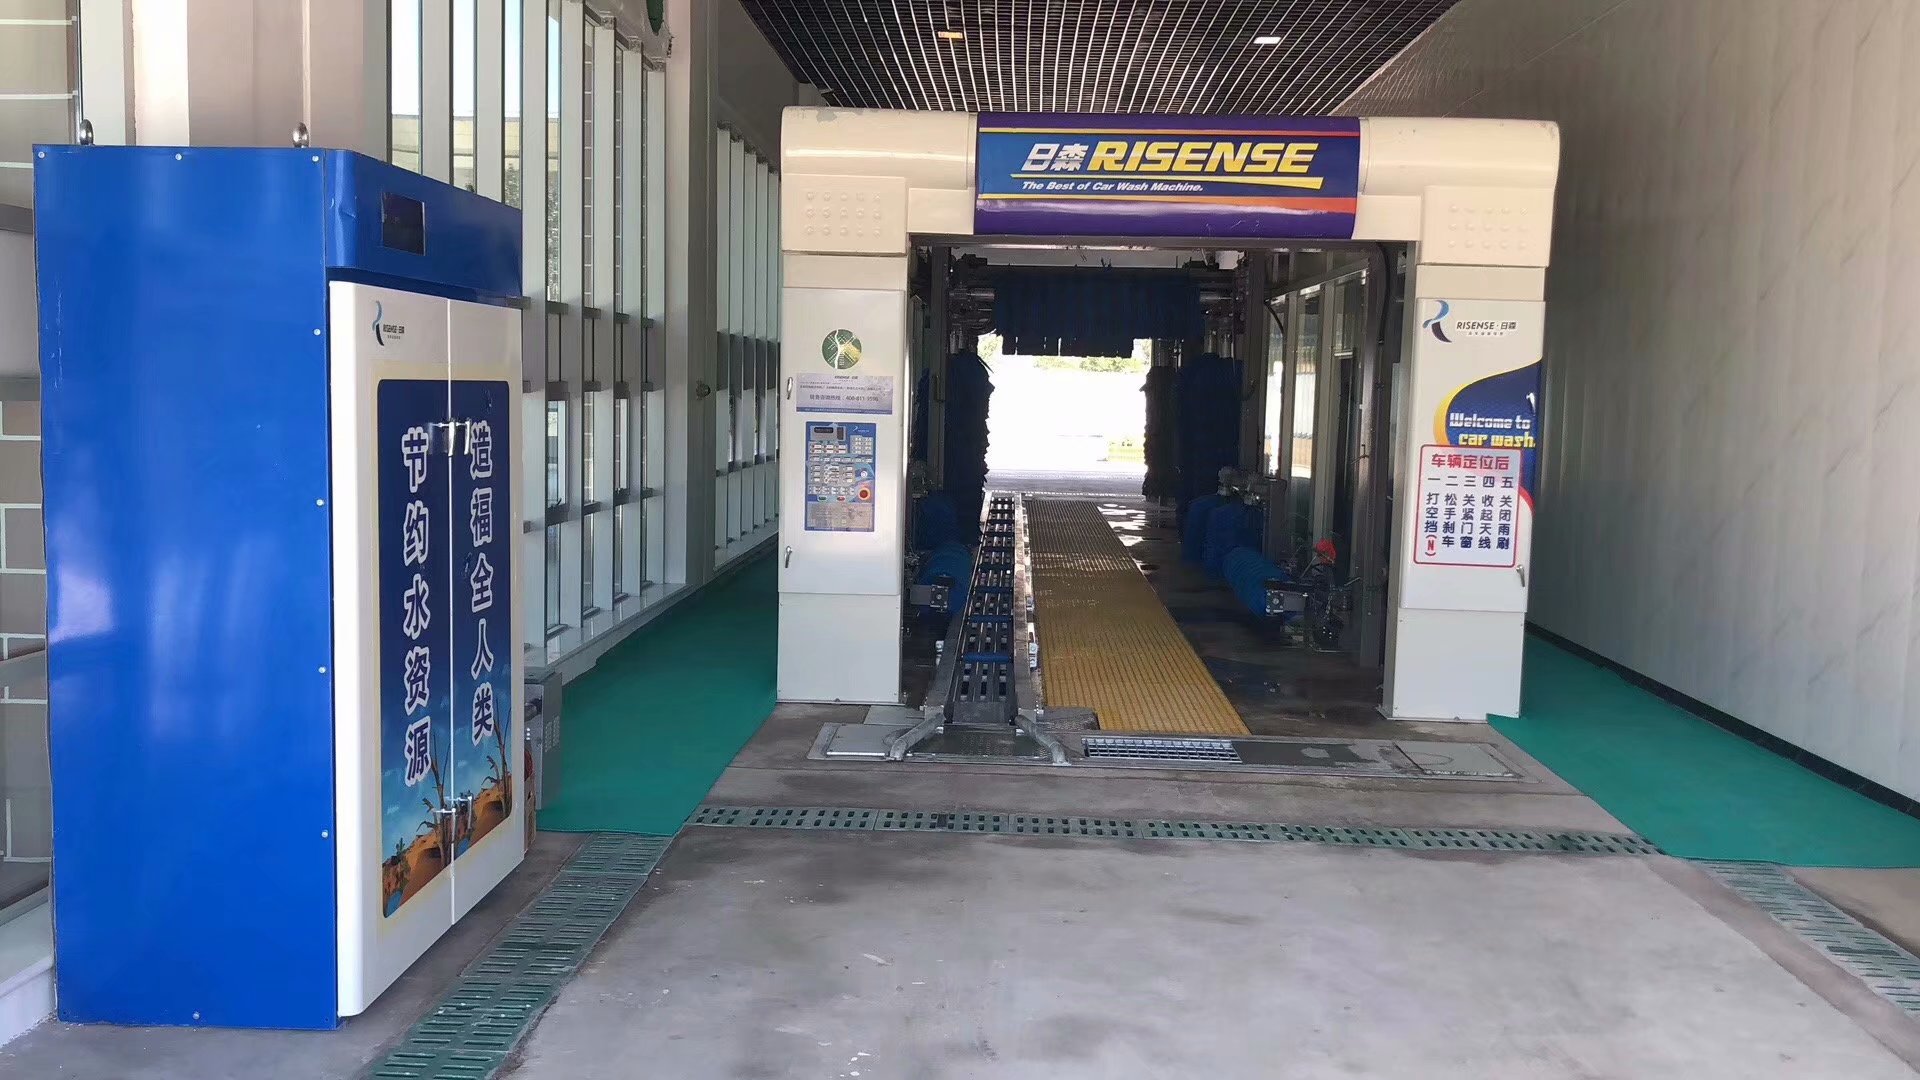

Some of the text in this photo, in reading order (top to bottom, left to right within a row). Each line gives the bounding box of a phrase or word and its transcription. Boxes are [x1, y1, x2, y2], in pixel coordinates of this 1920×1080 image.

[1021, 141, 1319, 173] 日森 RISENSE
[1022, 181, 1204, 192] The Best of Car Wash Machine.
[1449, 412, 1531, 429] Welcome to
[1458, 433, 1488, 446] car
[1431, 453, 1510, 470] 车辆定位后
[1441, 493, 1458, 548] 松手刹车
[1460, 493, 1476, 549] 关紧门窗
[1478, 494, 1494, 549] 收起天线
[1496, 495, 1513, 550] 关闭雨刷
[402, 426, 431, 787] 节约水资源
[470, 420, 494, 746] 造福全人类
